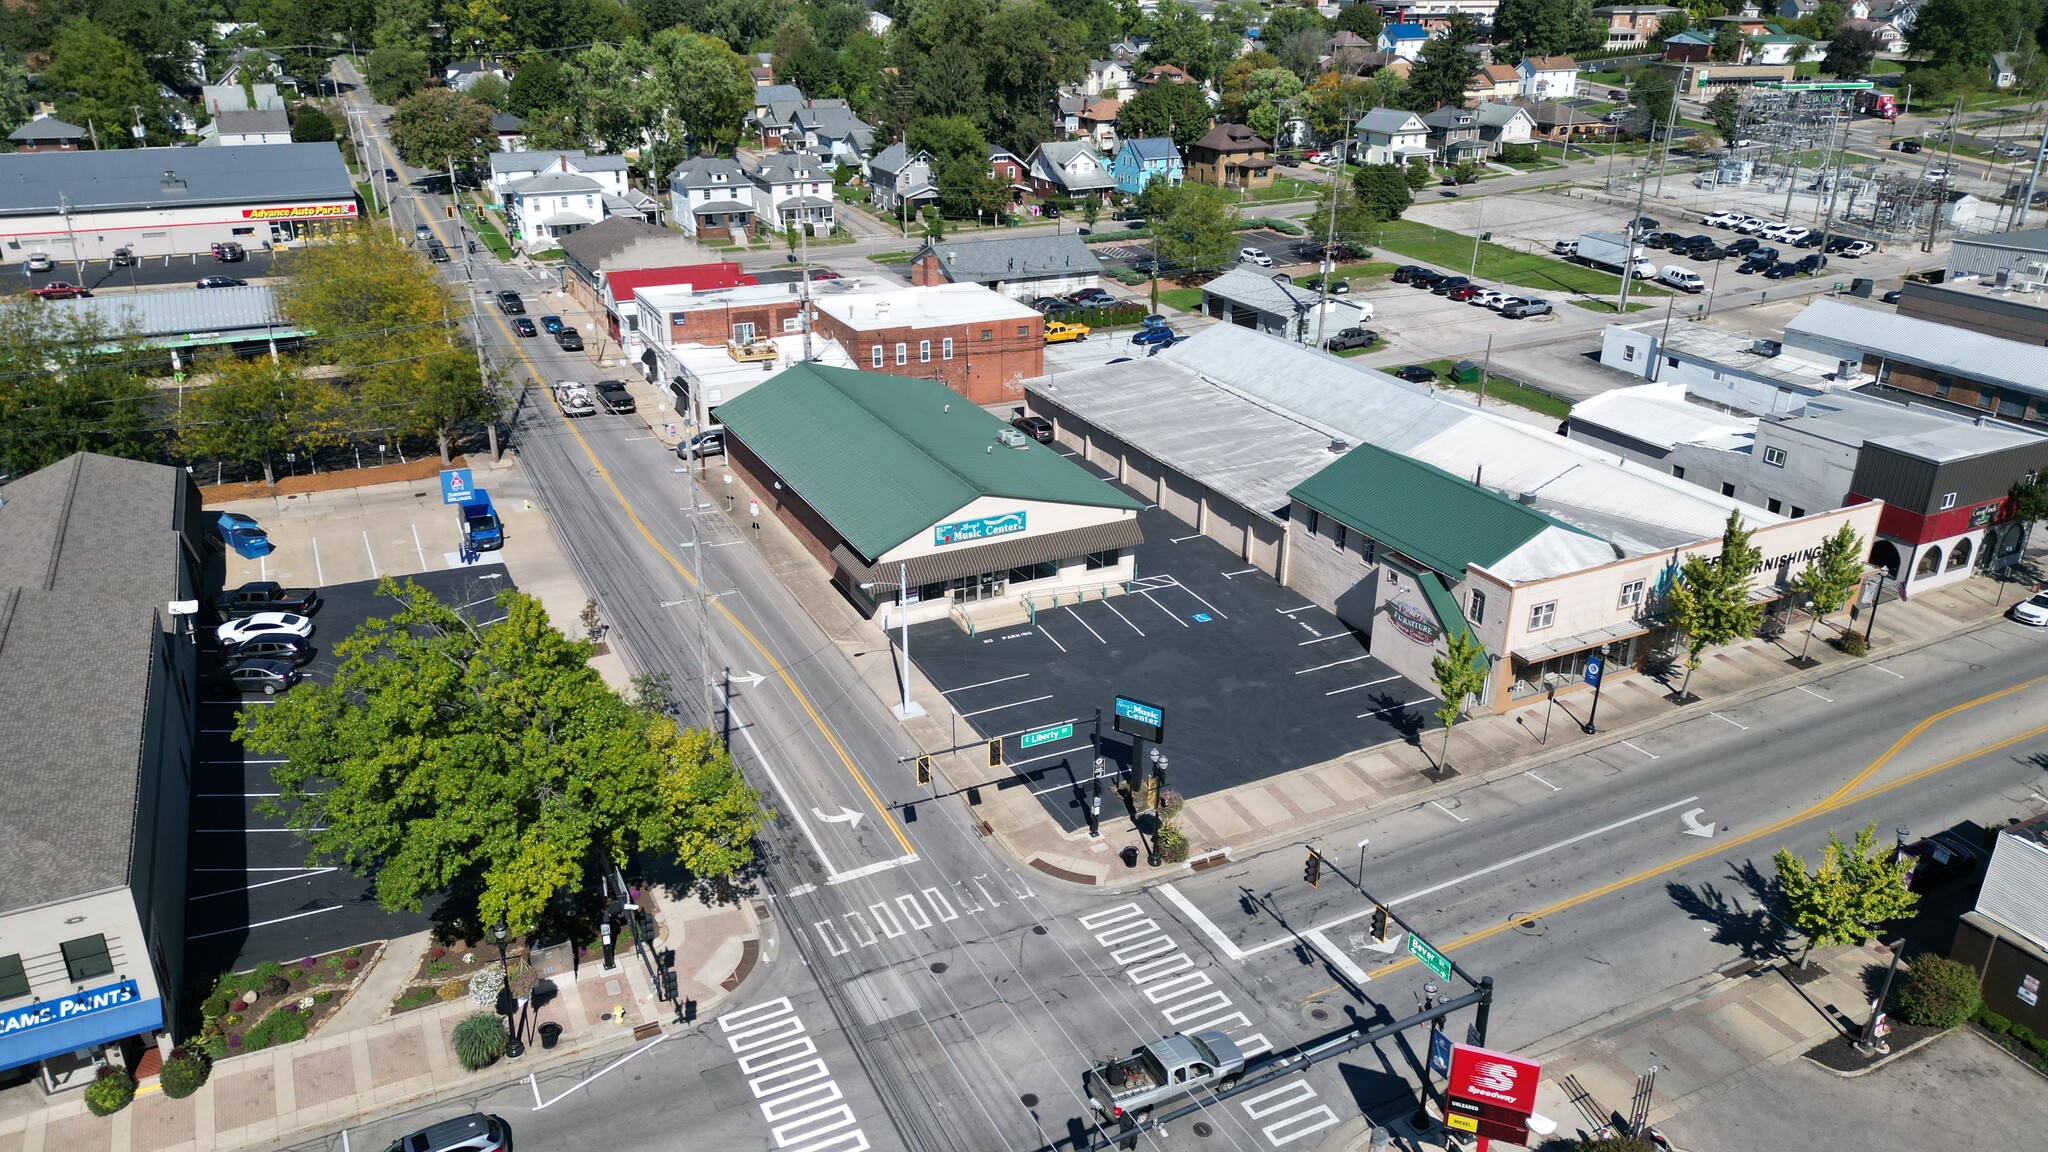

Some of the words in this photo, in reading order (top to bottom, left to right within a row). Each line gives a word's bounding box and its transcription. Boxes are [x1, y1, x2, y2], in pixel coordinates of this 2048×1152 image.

[250, 208, 290, 219] Advance
[291, 207, 315, 216] Auto
[315, 205, 341, 215] Parts
[953, 529, 982, 541] Music
[985, 523, 1018, 535] Center
[1754, 545, 1822, 575] RNISHING
[1393, 611, 1433, 635] FURNITURE
[1001, 631, 1033, 641] PARKING
[1126, 710, 1158, 725] Center
[1133, 705, 1158, 719] Music
[1031, 730, 1060, 743] Liberty
[1412, 938, 1435, 961] Bever
[0, 1007, 57, 1034] AMS.
[59, 987, 132, 1018] PAINTS
[1467, 1085, 1518, 1104] Speedway
[1451, 1100, 1479, 1112] UNLEADED
[1453, 1118, 1472, 1128] DIESEL
